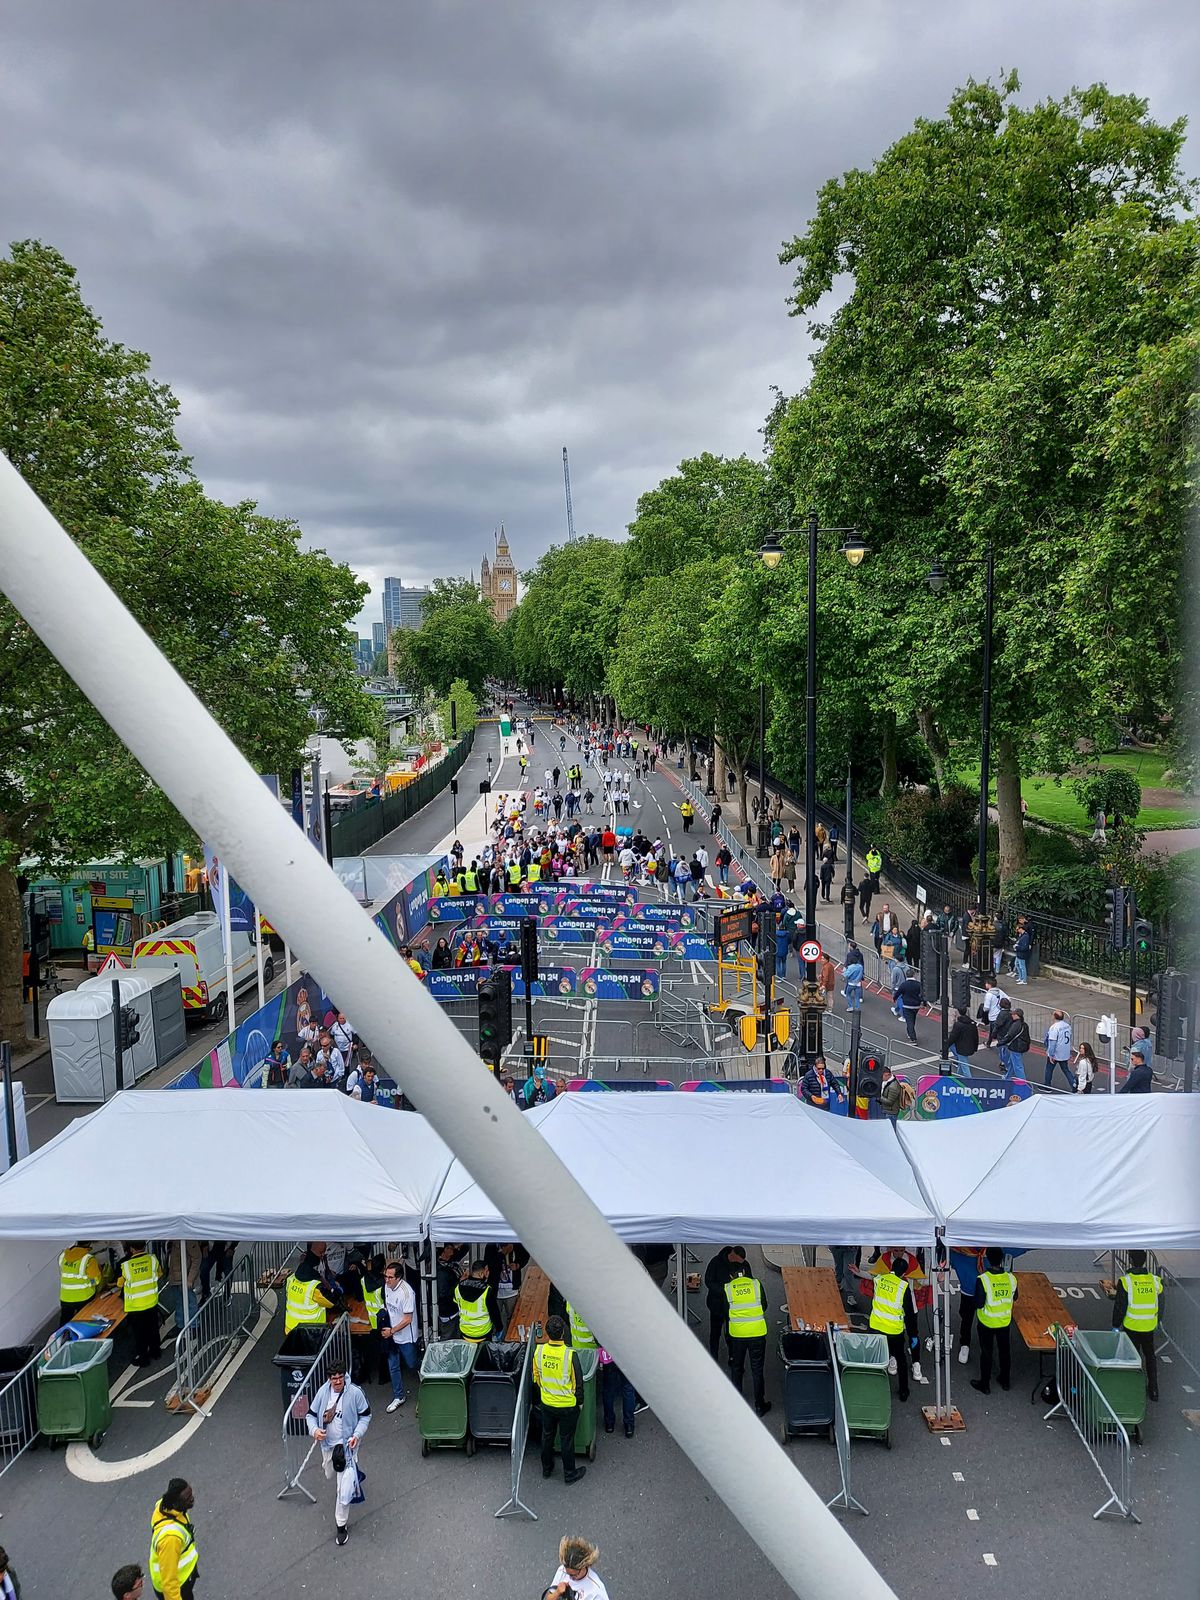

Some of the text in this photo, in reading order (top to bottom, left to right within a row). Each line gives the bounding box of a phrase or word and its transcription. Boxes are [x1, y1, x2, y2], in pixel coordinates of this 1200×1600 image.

[109, 870, 129, 879] SITE
[655, 924, 665, 932] 24
[642, 937, 653, 945] 24
[803, 947, 818, 956] 20
[463, 973, 475, 982] 24
[547, 972, 559, 982] 24
[629, 975, 641, 983] 24
[1064, 1030, 1070, 1045] 5
[989, 1088, 1006, 1099] 24
[543, 1361, 559, 1370] 4251
